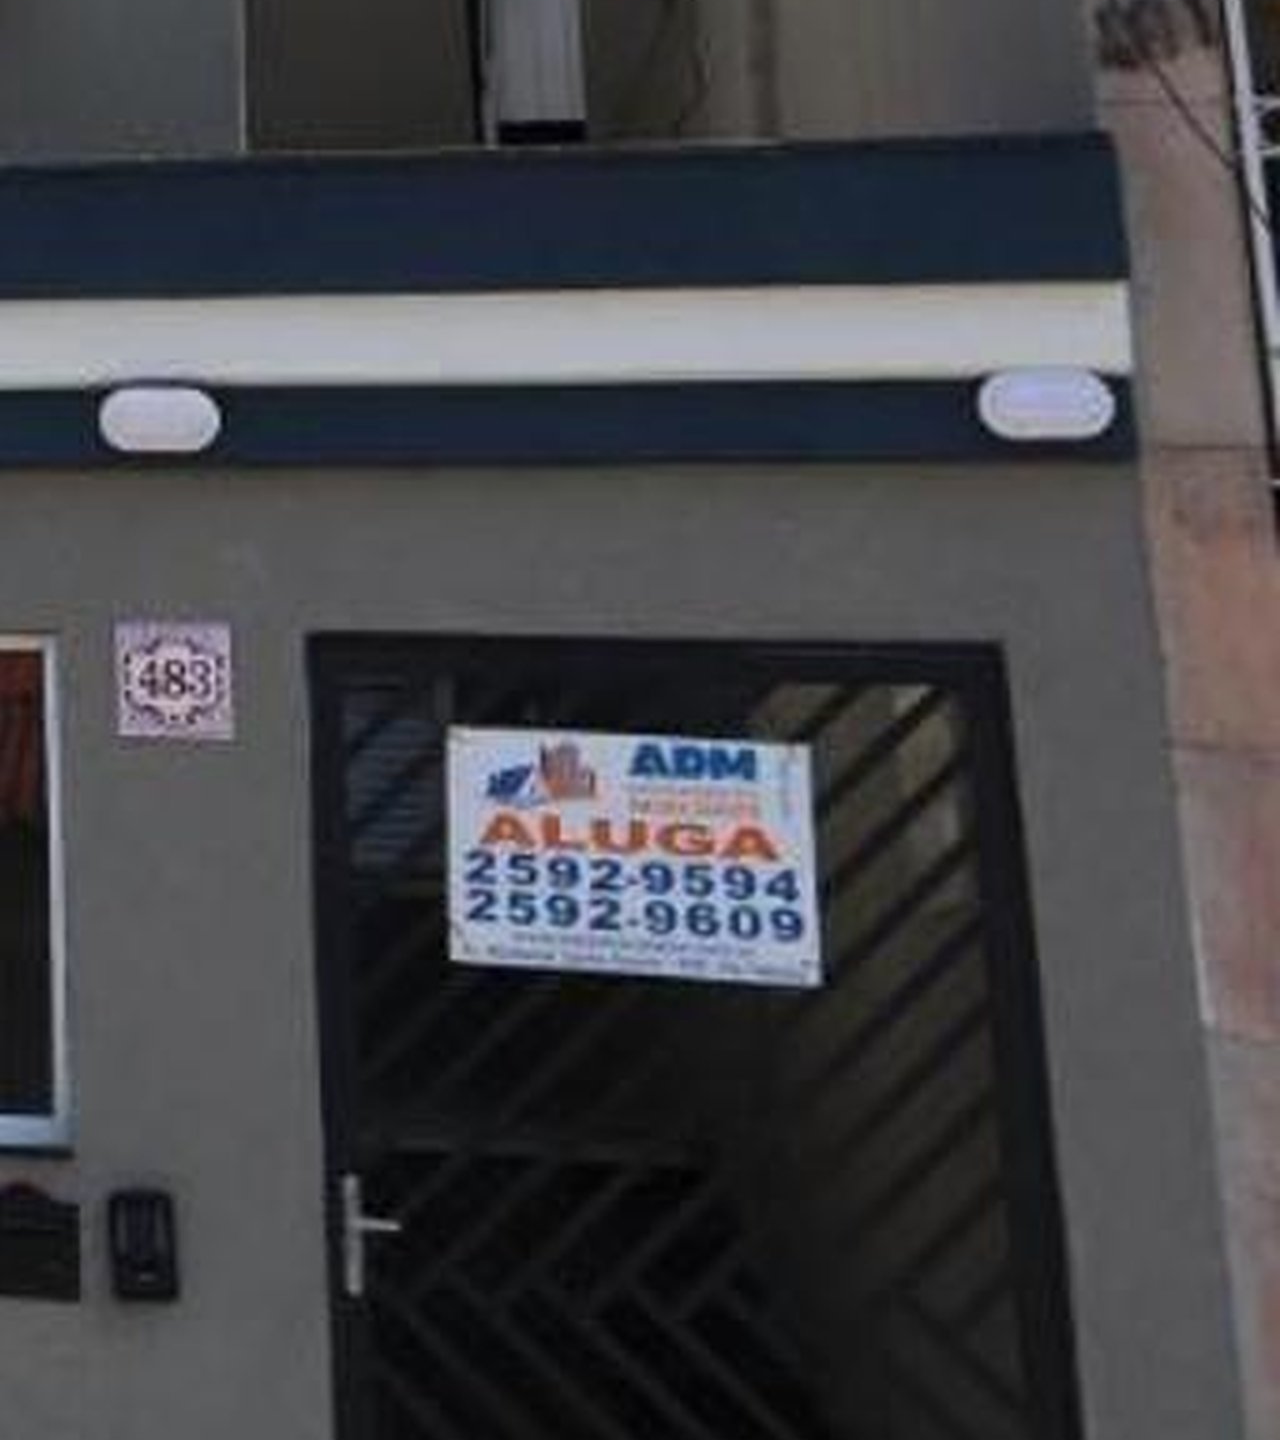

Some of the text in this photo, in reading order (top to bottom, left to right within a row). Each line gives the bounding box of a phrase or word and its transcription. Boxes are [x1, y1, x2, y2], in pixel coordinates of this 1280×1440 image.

[138, 659, 212, 700] 483
[629, 742, 757, 782] ADM
[479, 812, 778, 861] ALUGA
[464, 850, 801, 903] 2592-9594
[465, 889, 805, 942] 2592-9609
